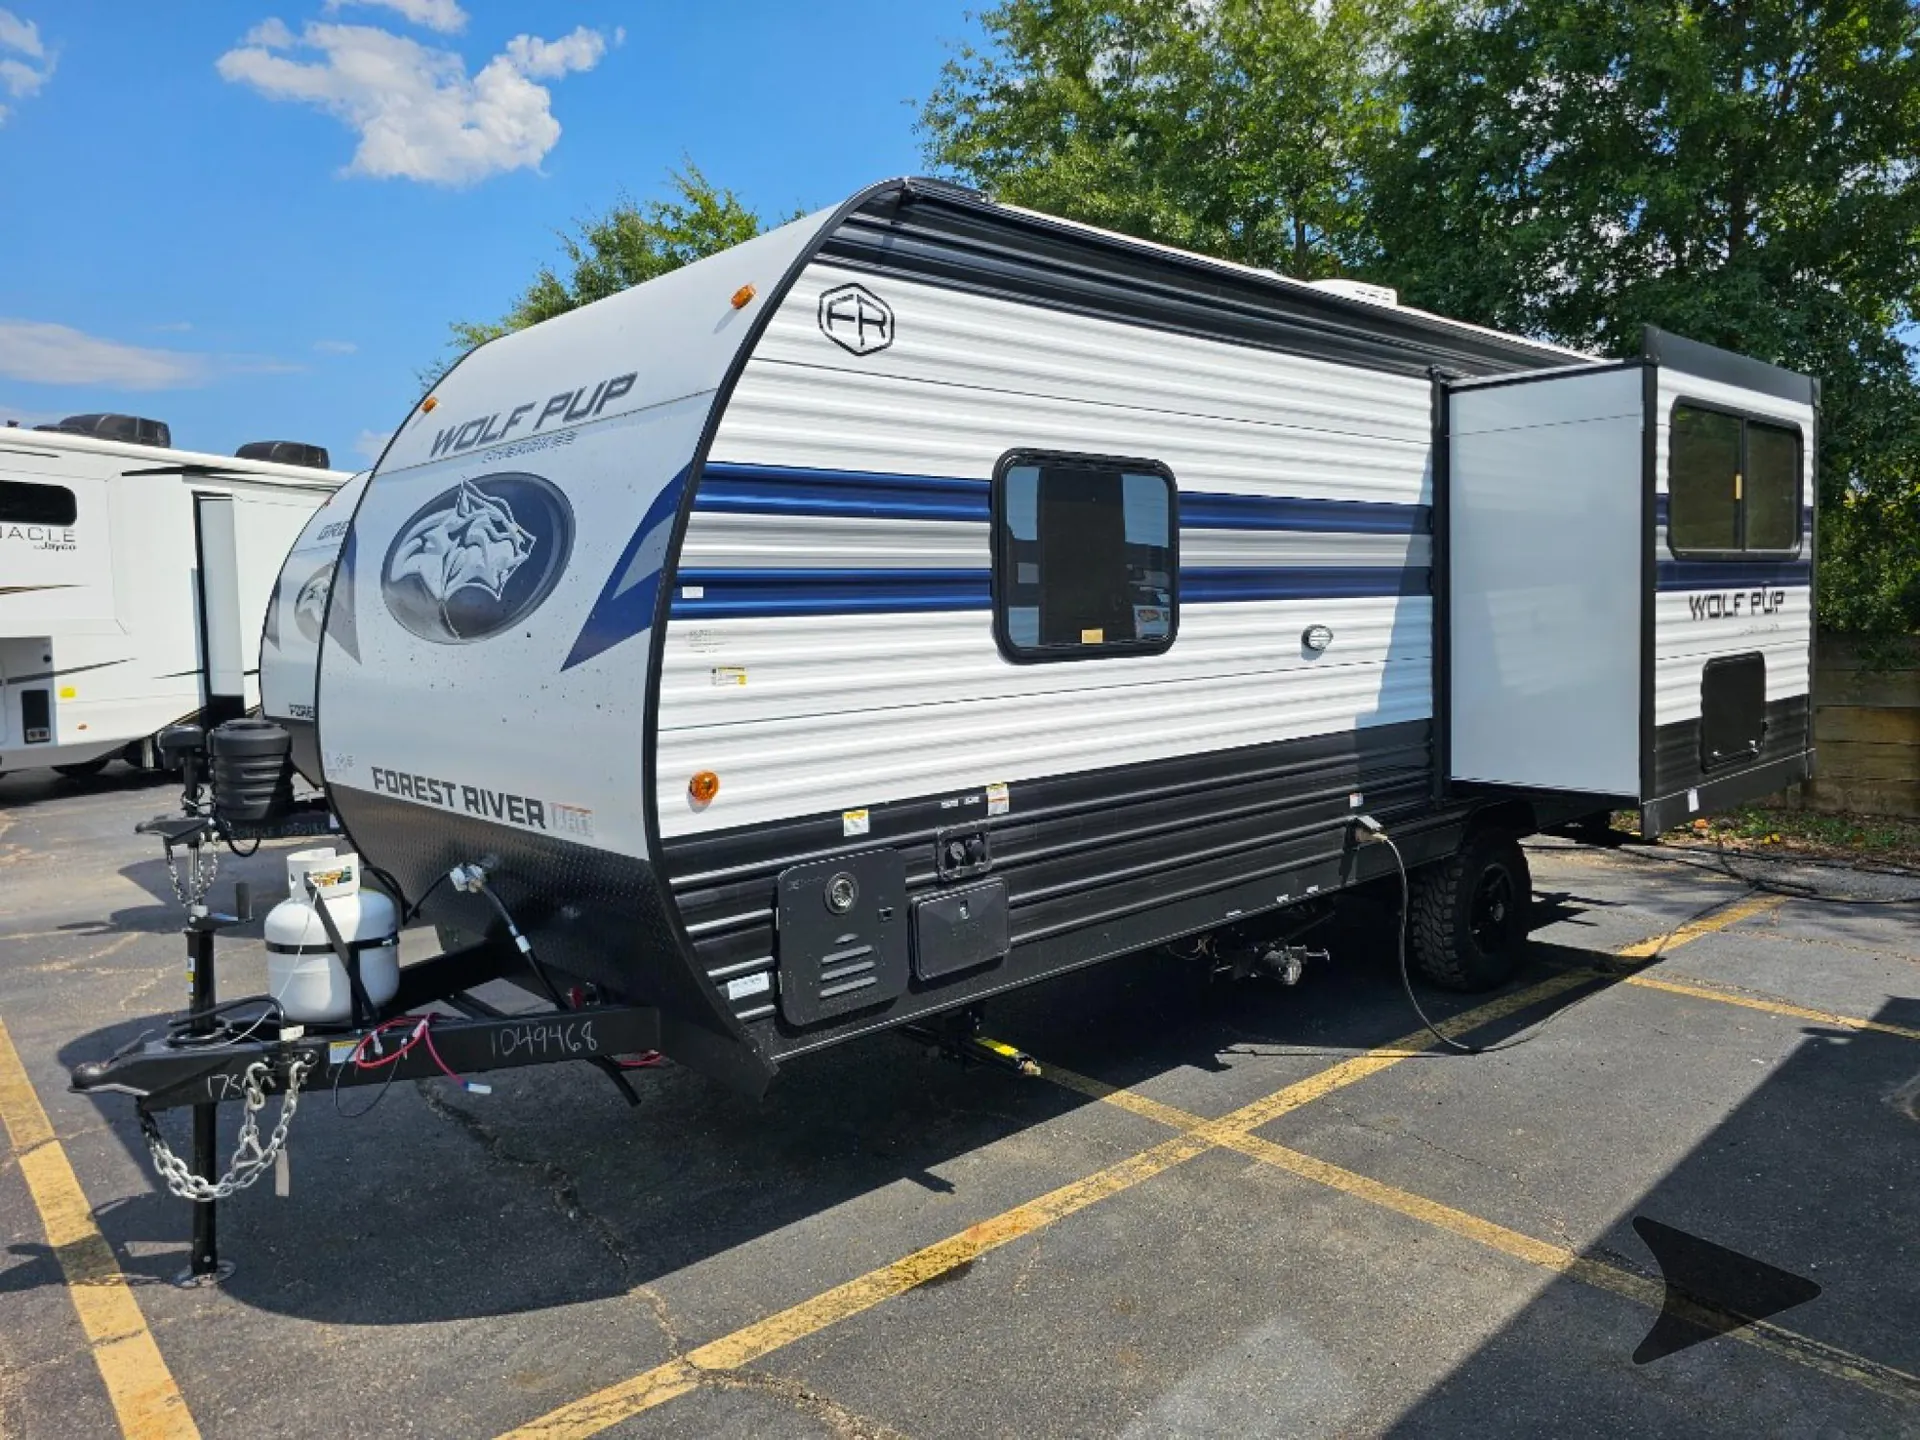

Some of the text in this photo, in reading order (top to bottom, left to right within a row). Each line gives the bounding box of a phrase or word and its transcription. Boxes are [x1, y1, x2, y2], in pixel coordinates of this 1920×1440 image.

[429, 371, 639, 458] WOLF PUP
[0, 526, 76, 542] ACLE
[1688, 588, 1785, 621] WOLF PUP
[371, 766, 457, 808] FOREST
[461, 785, 547, 830] RIVER
[490, 1021, 599, 1058] 1049468
